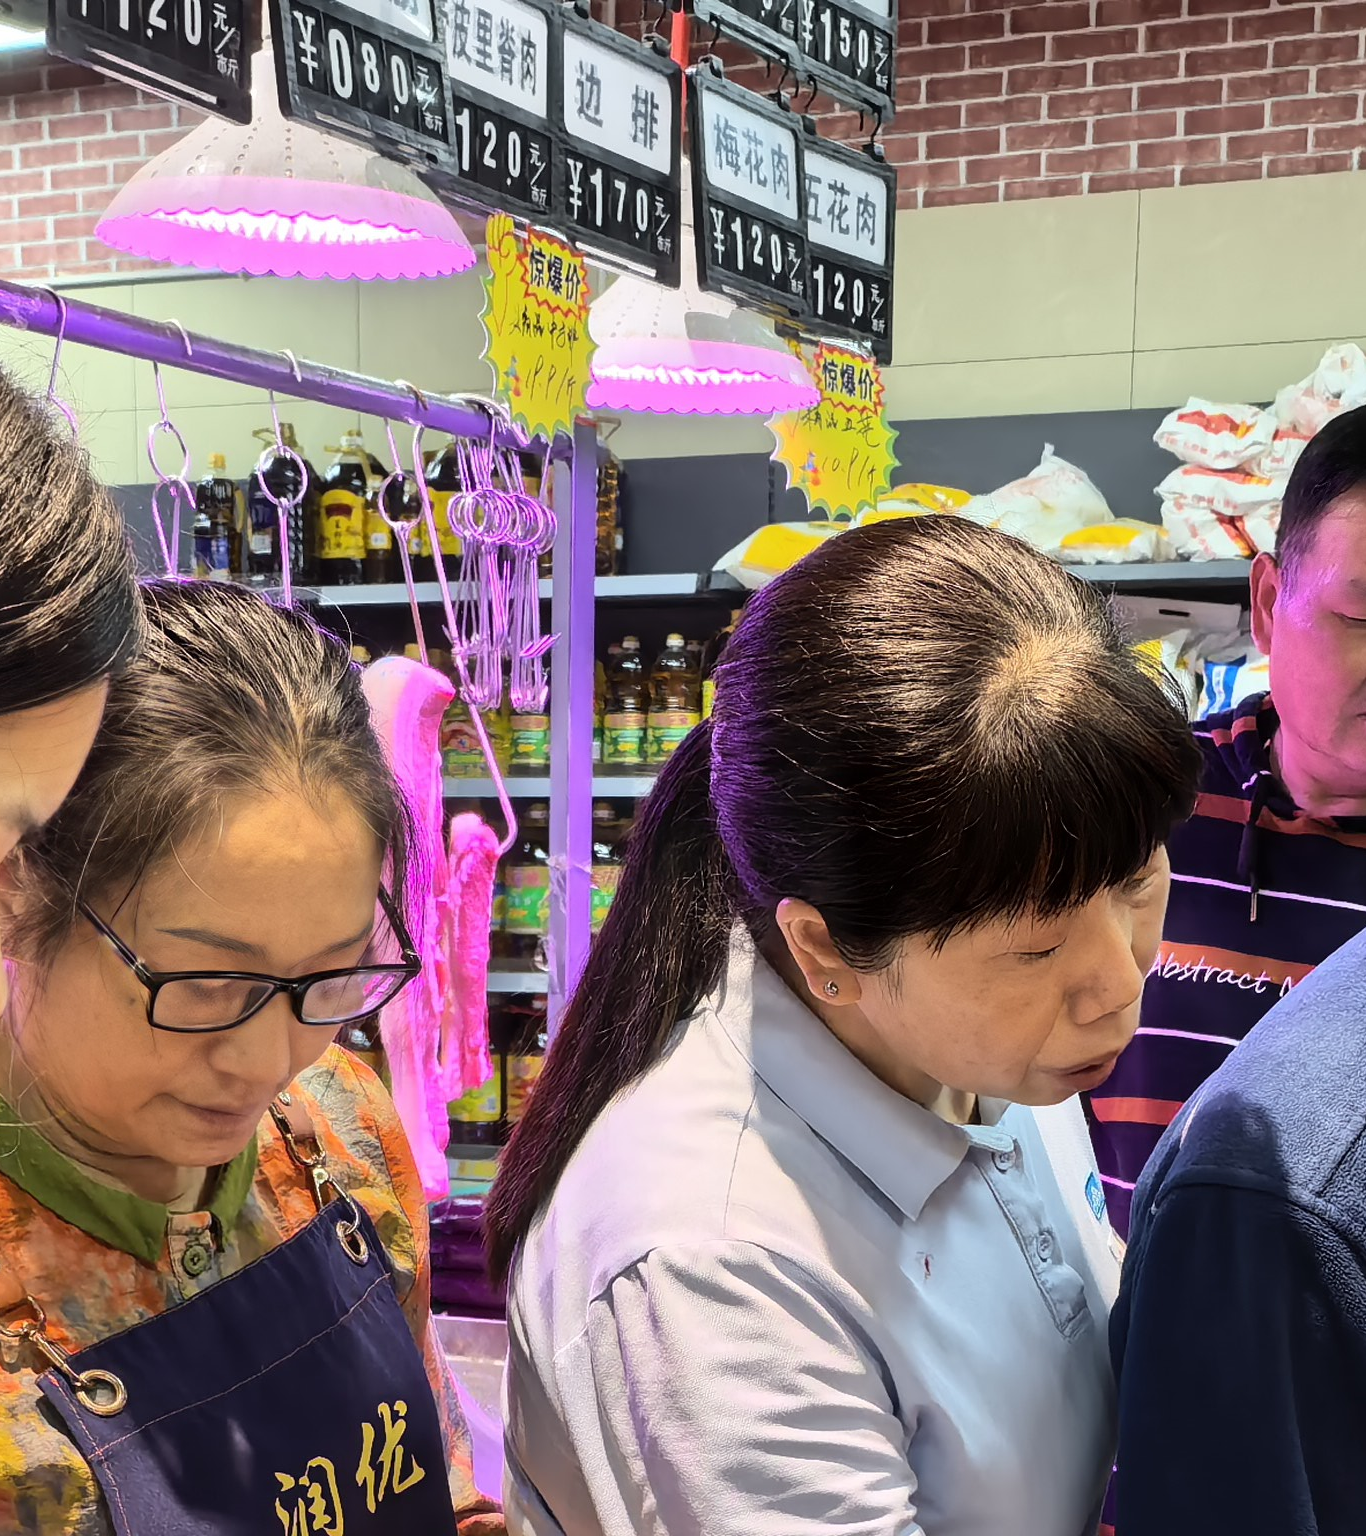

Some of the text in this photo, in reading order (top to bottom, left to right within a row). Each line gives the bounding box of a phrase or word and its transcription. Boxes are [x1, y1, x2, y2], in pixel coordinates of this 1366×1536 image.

[575, 58, 660, 151] 边排
[713, 113, 791, 201] 梅花肉
[804, 172, 876, 246] 五花肉
[529, 248, 581, 306] 惊爆价
[822, 358, 874, 402] 惊爆价
[1144, 951, 1272, 995] Abstract
